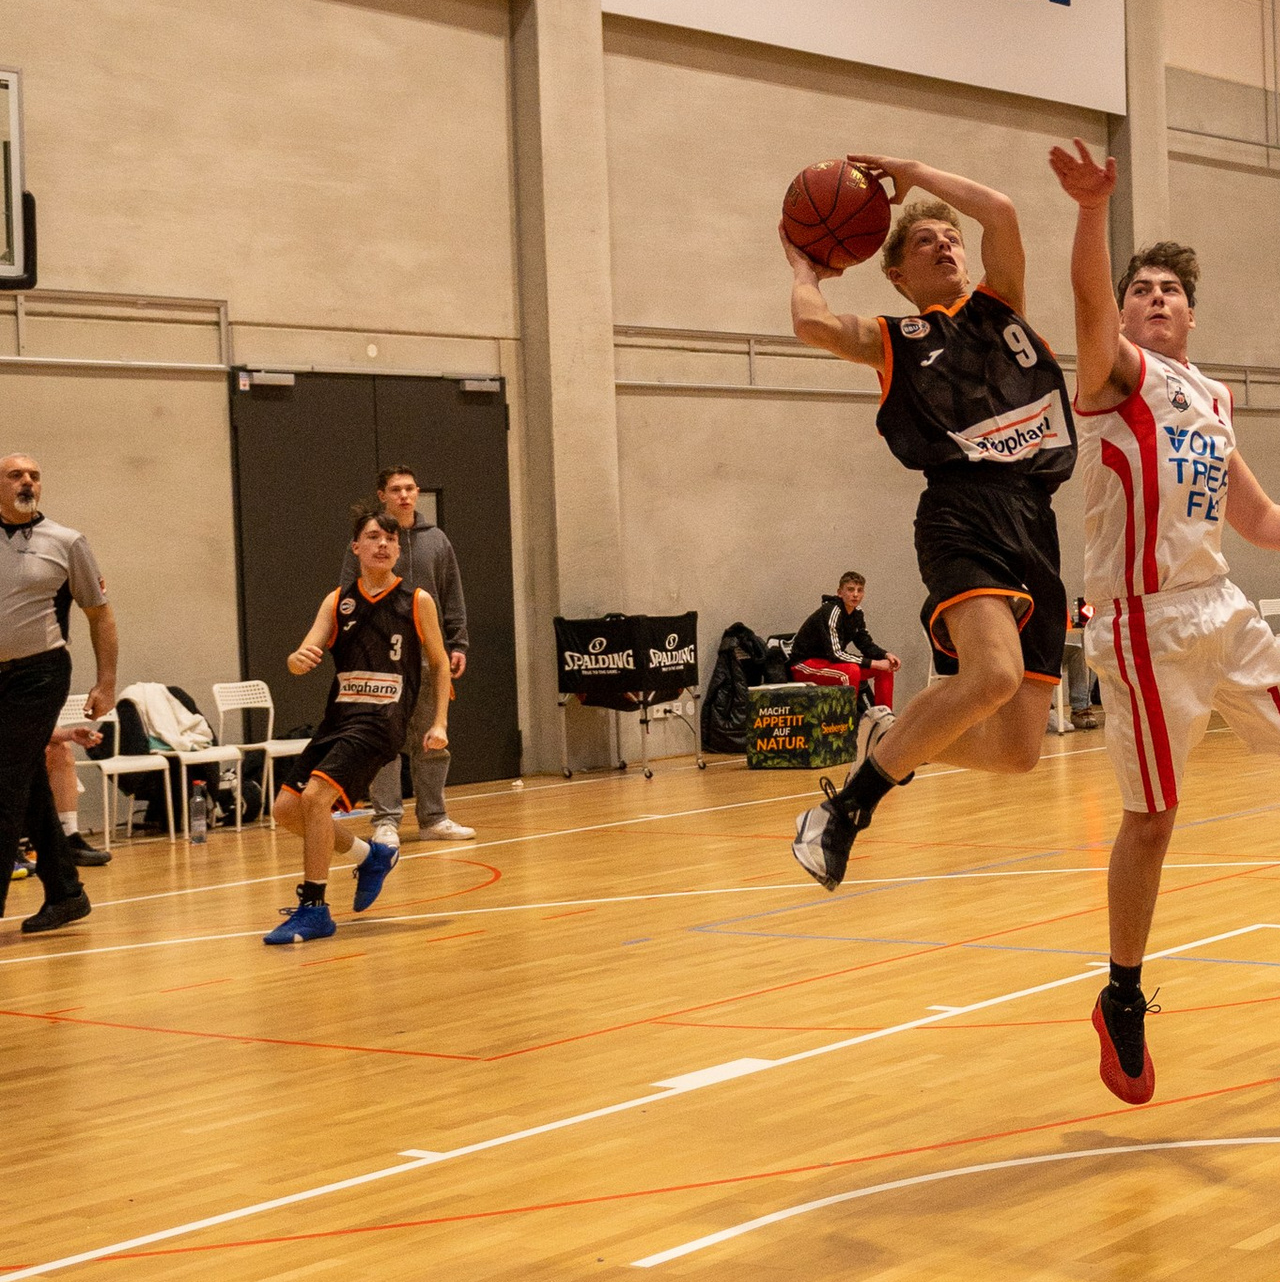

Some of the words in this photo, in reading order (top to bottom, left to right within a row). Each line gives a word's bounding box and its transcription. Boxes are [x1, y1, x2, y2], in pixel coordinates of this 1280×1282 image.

[1003, 324, 1038, 368] 9
[1163, 425, 1226, 462] VOL
[389, 634, 403, 661] 3
[564, 650, 634, 670] SPALDING
[649, 645, 695, 669] SPALDING
[759, 706, 790, 716] MACHT
[753, 715, 804, 729] APPETIT
[821, 723, 848, 735] Seeberger
[773, 728, 791, 736] AUF
[756, 736, 808, 751] NATUR.
